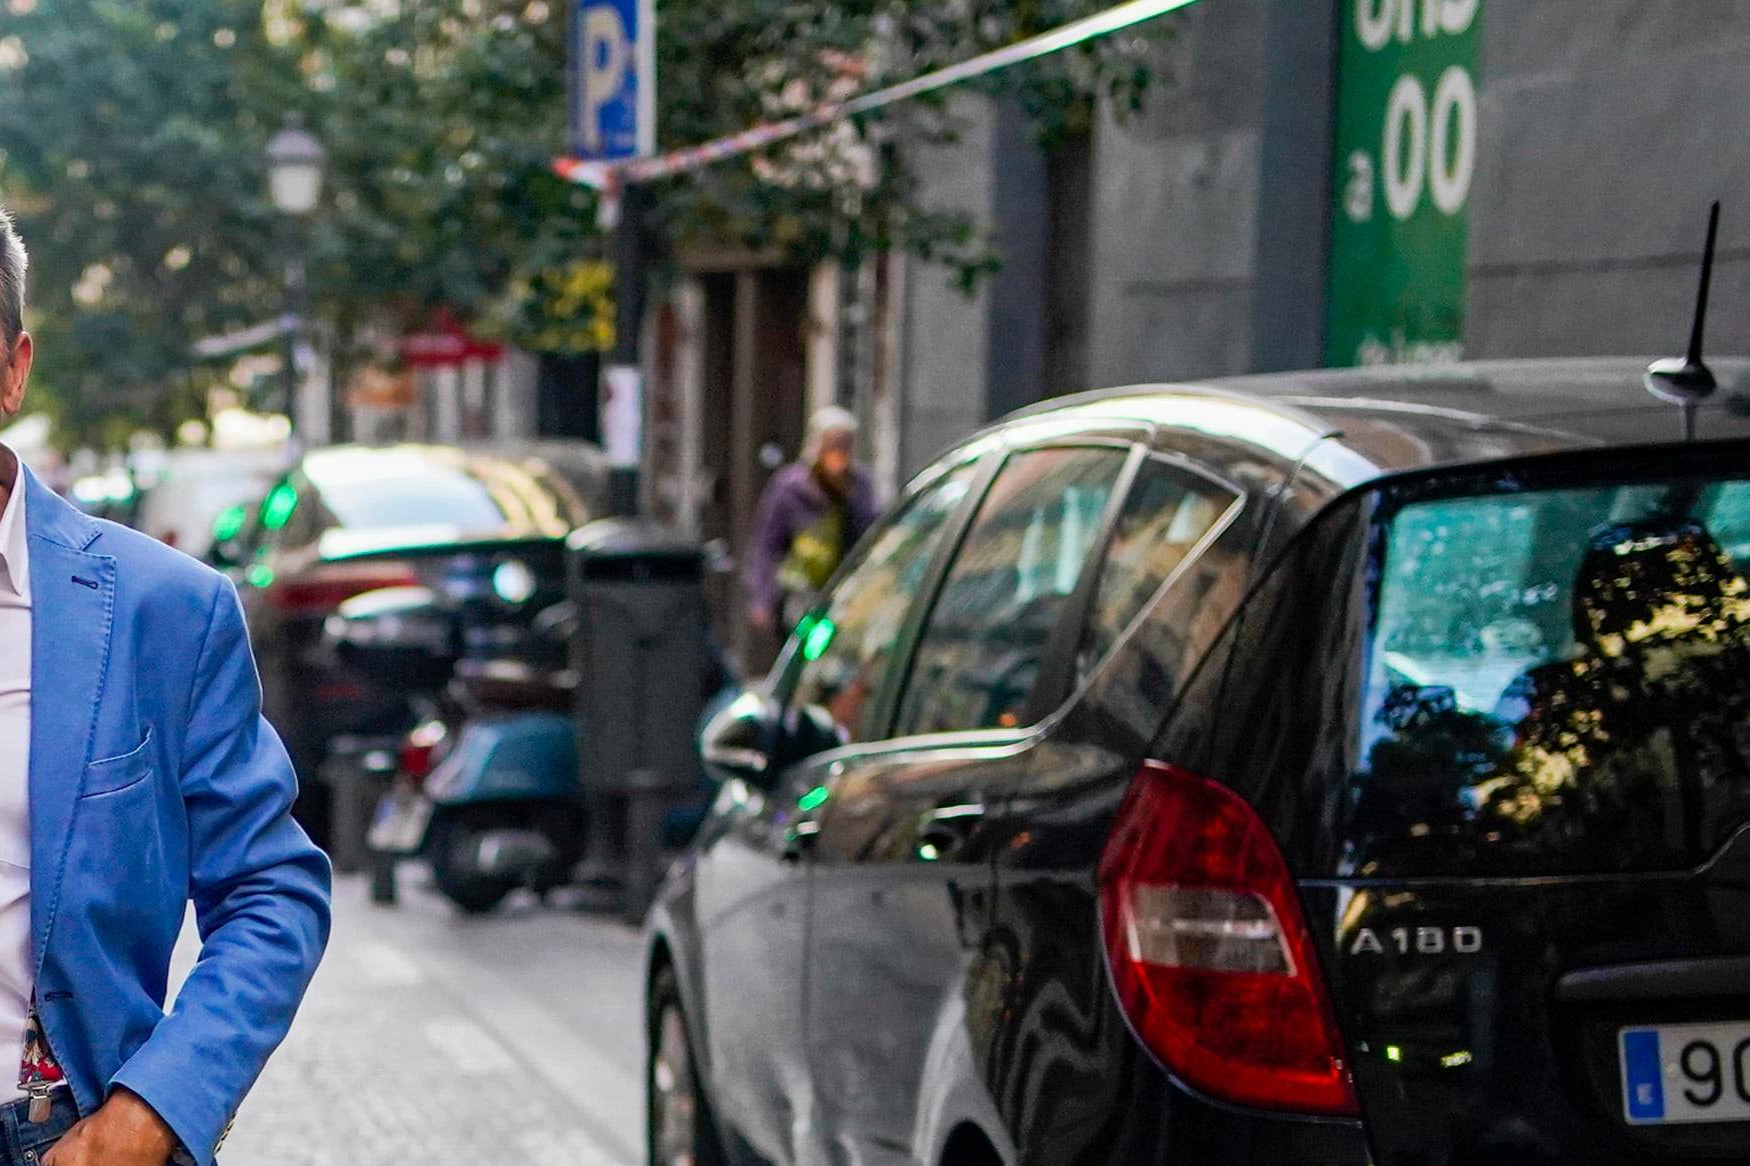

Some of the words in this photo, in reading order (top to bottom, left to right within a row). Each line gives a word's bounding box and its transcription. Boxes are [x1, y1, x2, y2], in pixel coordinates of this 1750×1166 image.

[580, 7, 629, 149] P
[1382, 66, 1477, 219] 00
[1351, 926, 1482, 955] A180
